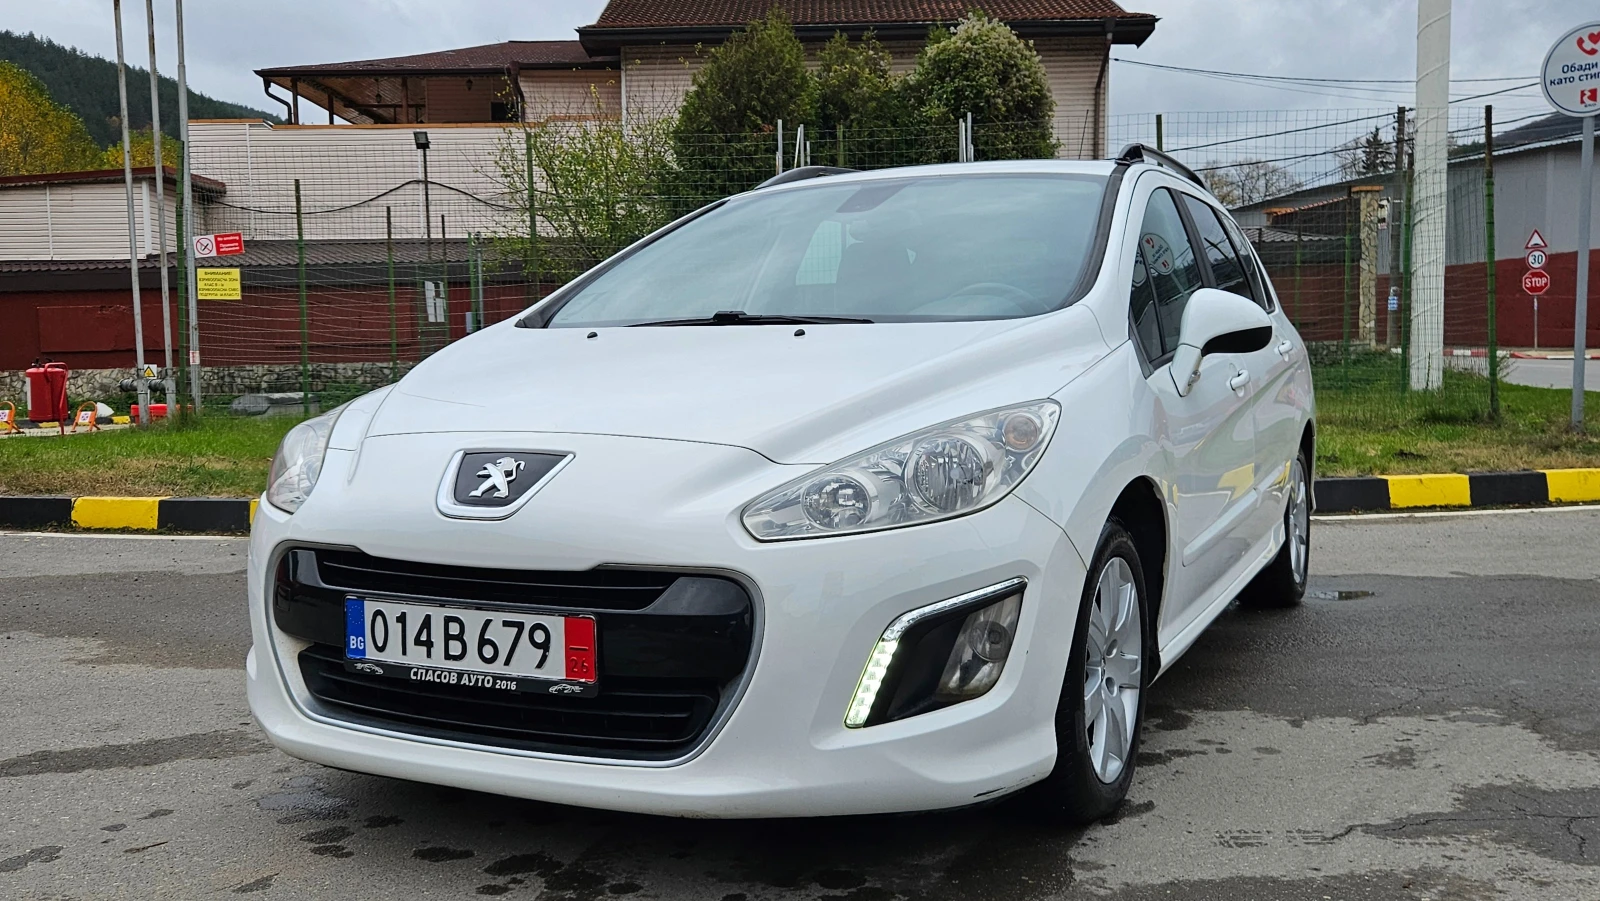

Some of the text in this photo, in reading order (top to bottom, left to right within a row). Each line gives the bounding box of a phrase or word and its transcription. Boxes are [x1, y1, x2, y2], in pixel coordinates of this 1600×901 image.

[1561, 61, 1598, 74] Обади
[1550, 76, 1575, 86] като
[1530, 254, 1544, 265] 30
[1525, 277, 1547, 288] STOP
[350, 635, 365, 650] BG
[569, 656, 589, 673] 26
[410, 668, 517, 690] СПАСОВ АУТО 2016
